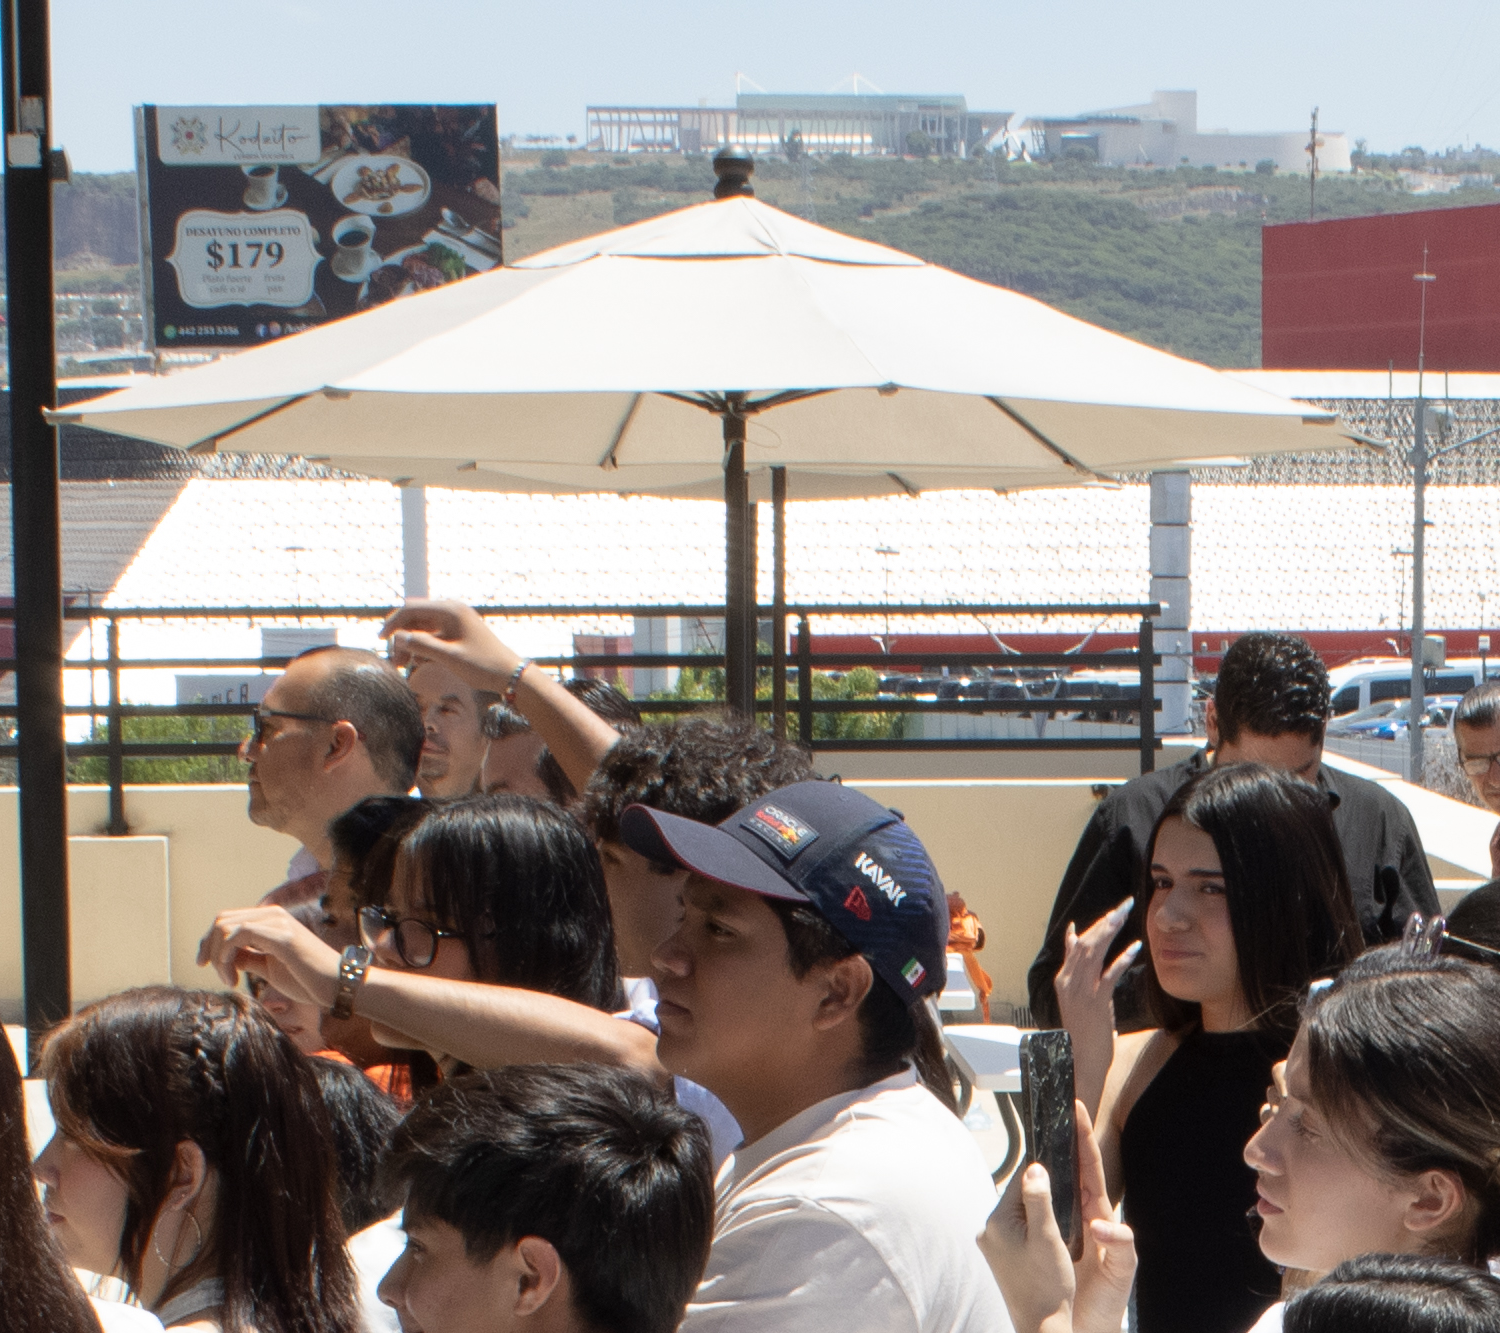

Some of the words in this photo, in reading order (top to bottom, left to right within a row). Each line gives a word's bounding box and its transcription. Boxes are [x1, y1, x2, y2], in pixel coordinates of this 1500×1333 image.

[186, 226, 242, 237] DESAYUNO
[243, 226, 301, 237] COMPLETO
[206, 238, 286, 272] $179
[764, 806, 808, 837] ORACLE
[854, 851, 907, 908] KAVAK
